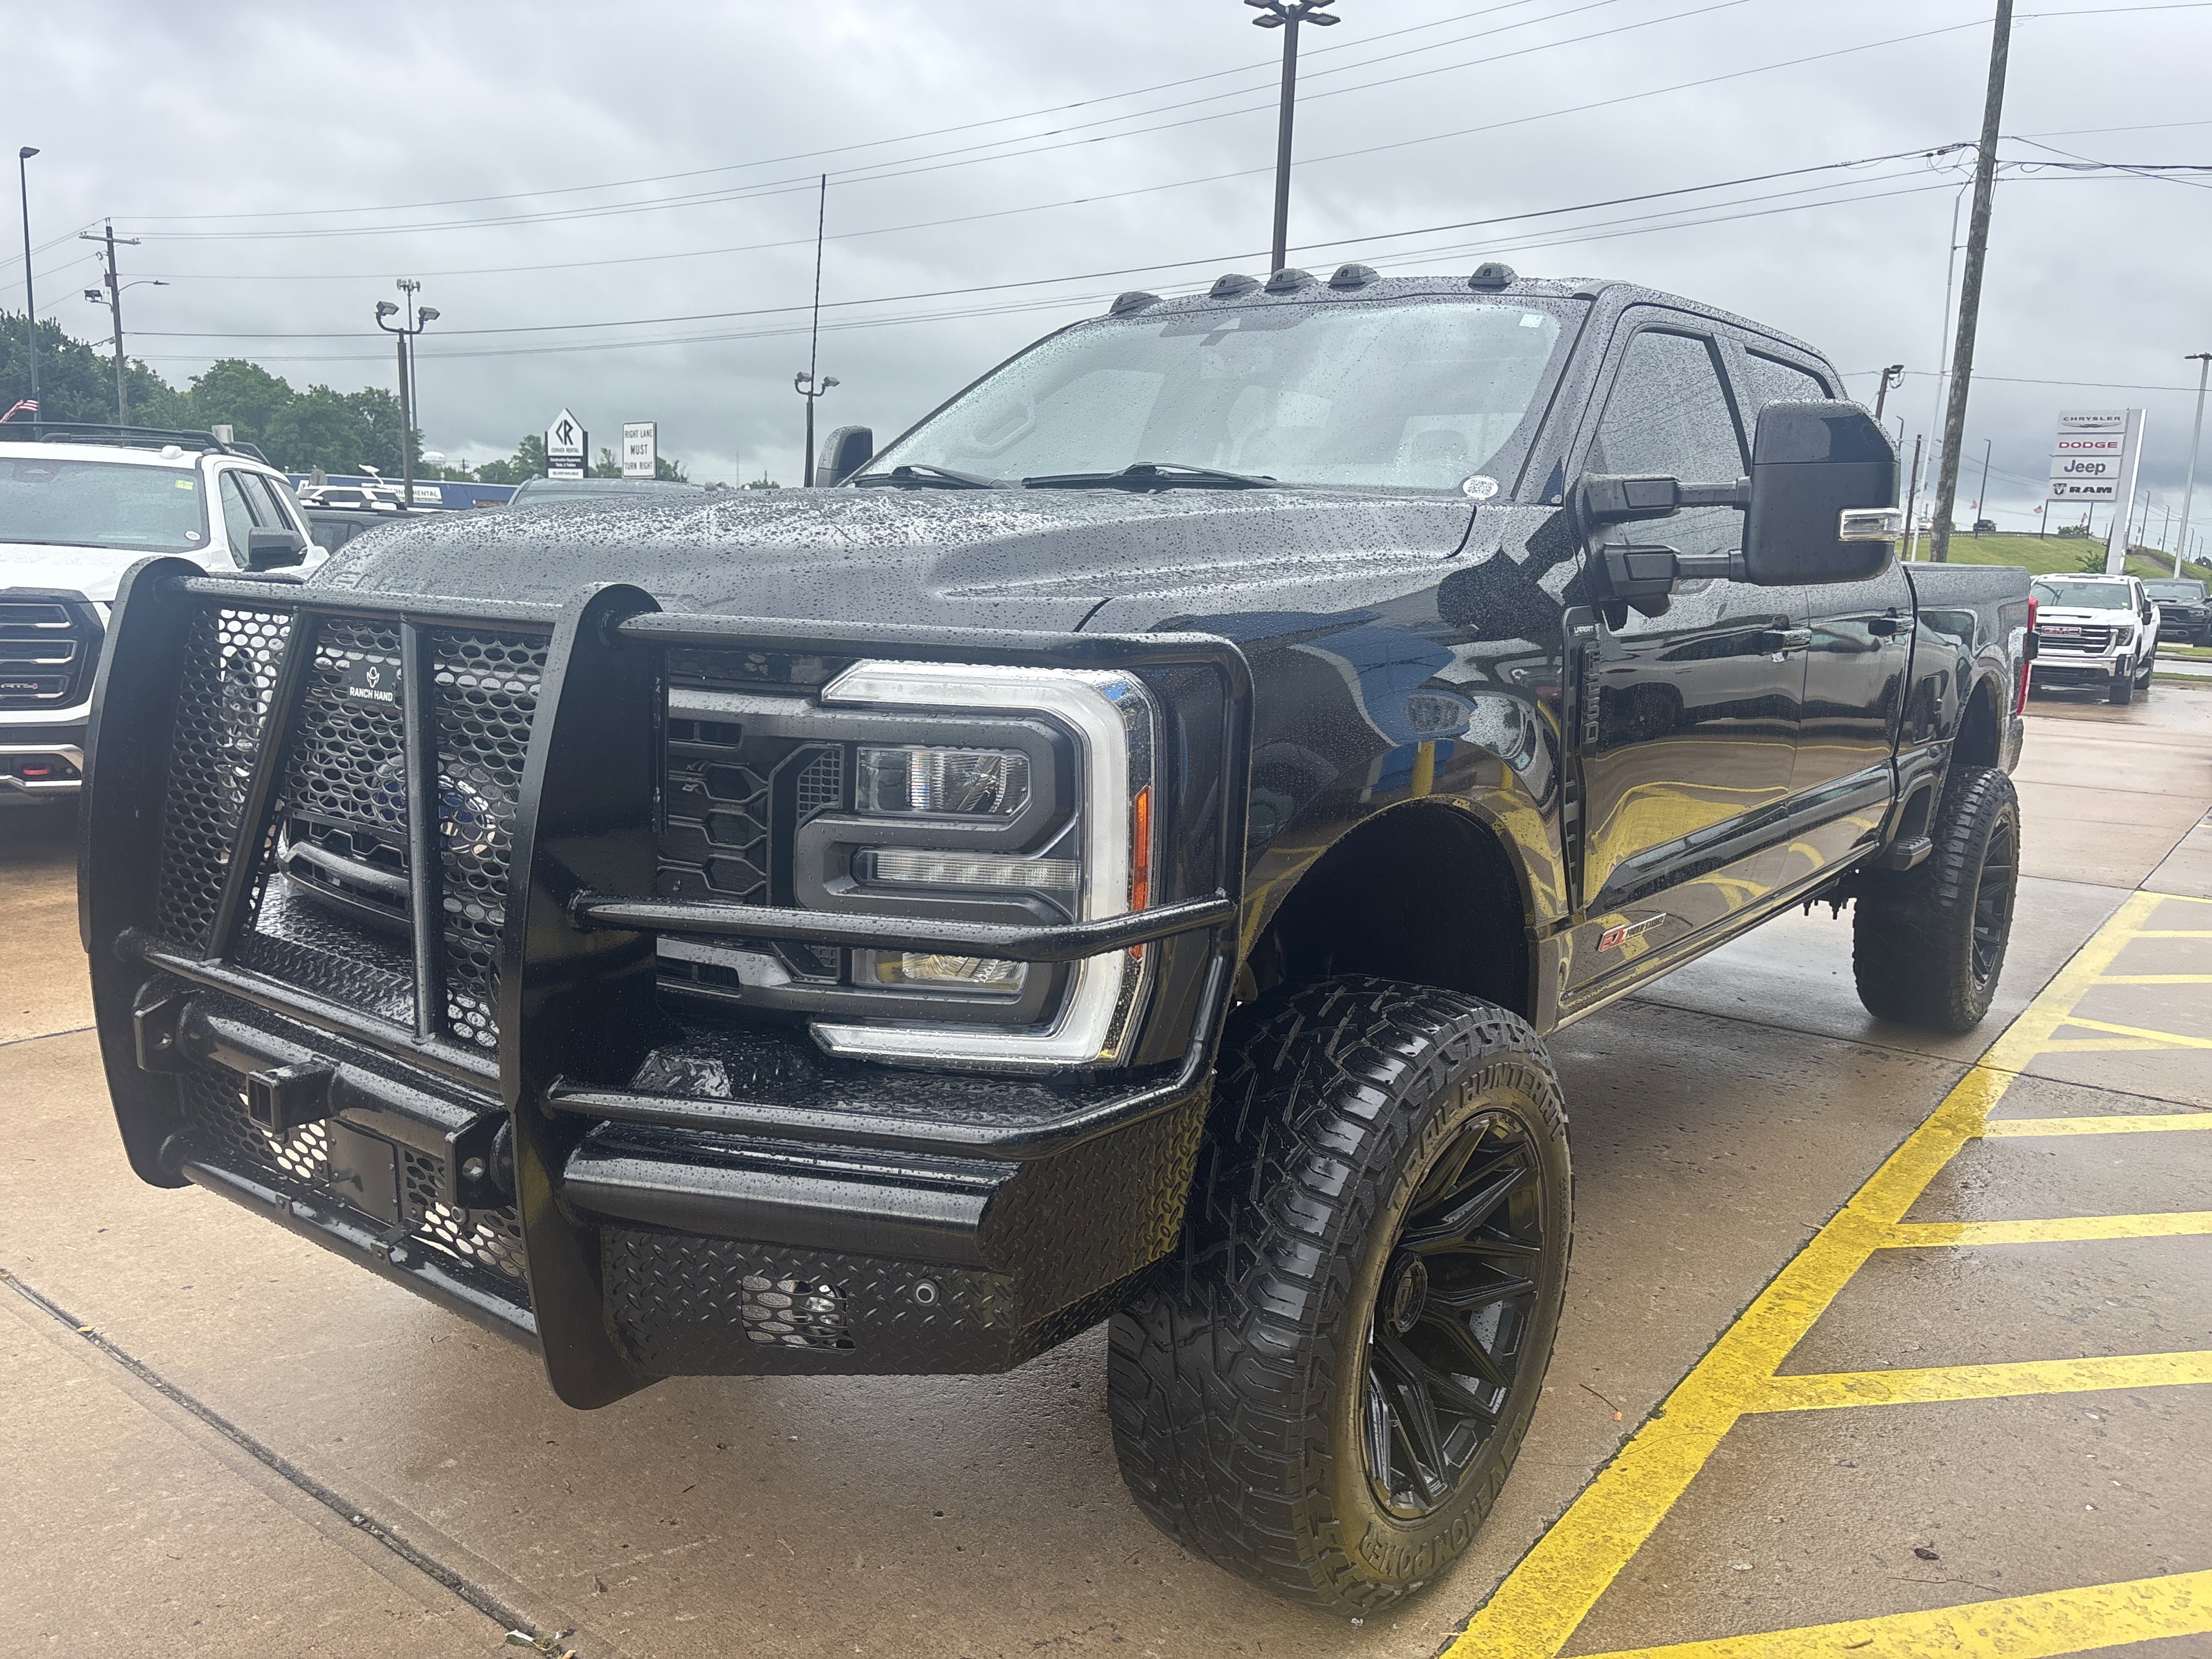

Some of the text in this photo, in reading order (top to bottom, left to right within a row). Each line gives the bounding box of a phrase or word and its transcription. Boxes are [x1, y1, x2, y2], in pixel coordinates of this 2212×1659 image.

[625, 429, 652, 438] RIGHT LANE
[630, 444, 647, 455] MUST
[624, 461, 652, 470] TURN RIGHT
[2064, 460, 2106, 475] Jeep
[349, 686, 393, 702] RANCH HAND
[1460, 1062, 1546, 1109] HUNTER
